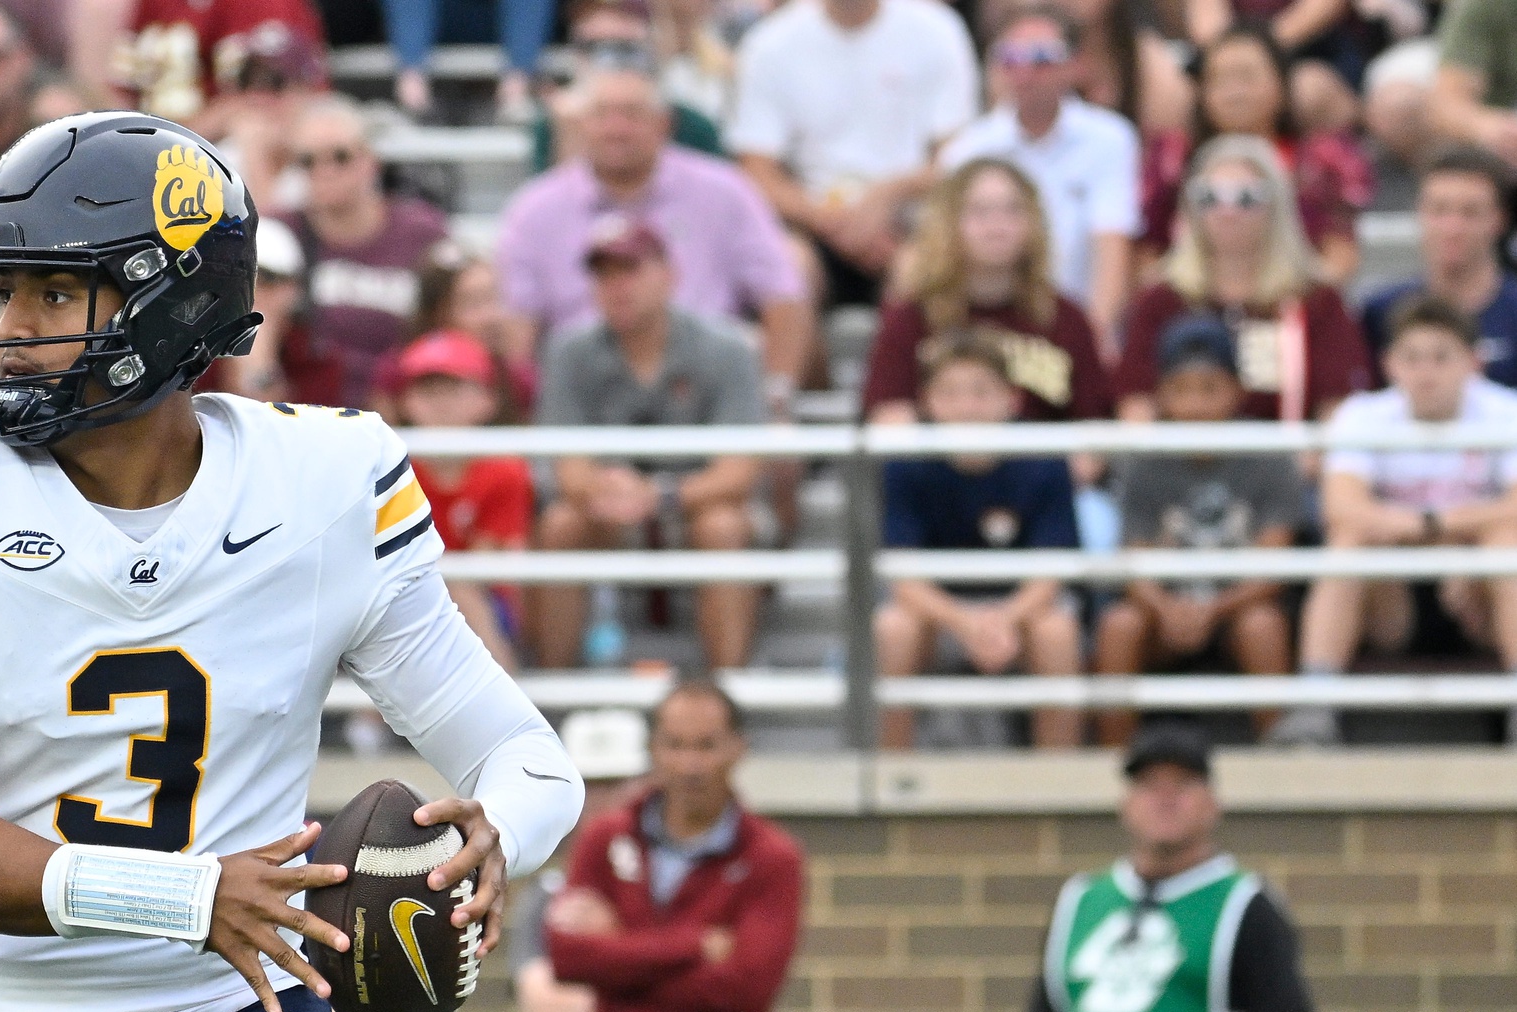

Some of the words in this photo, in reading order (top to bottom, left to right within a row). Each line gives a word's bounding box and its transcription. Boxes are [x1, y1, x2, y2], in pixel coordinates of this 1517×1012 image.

[161, 176, 213, 230] Cal
[2, 540, 55, 556] ACC
[129, 558, 160, 585] Cal
[53, 646, 212, 854] 3
